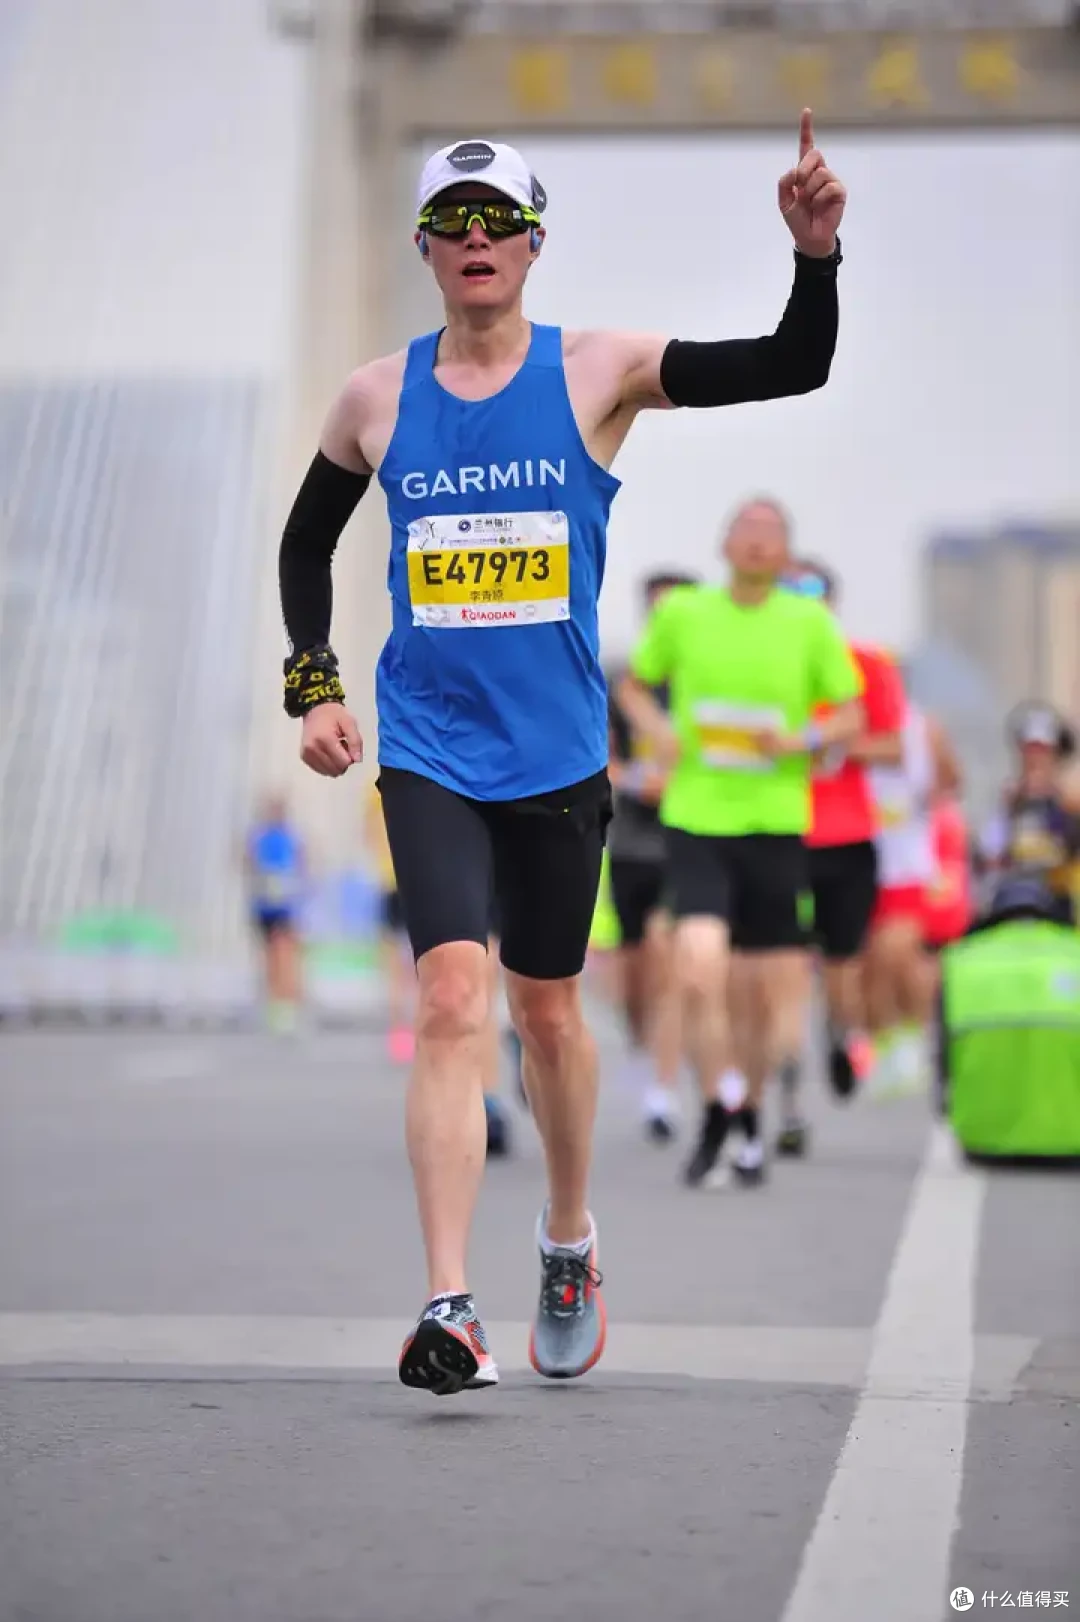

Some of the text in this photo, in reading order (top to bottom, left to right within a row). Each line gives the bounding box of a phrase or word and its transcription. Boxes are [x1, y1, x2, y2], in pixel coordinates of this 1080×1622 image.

[401, 459, 566, 499] GARMIN
[422, 550, 550, 586] E47973
[469, 610, 516, 621] QIAODAN
